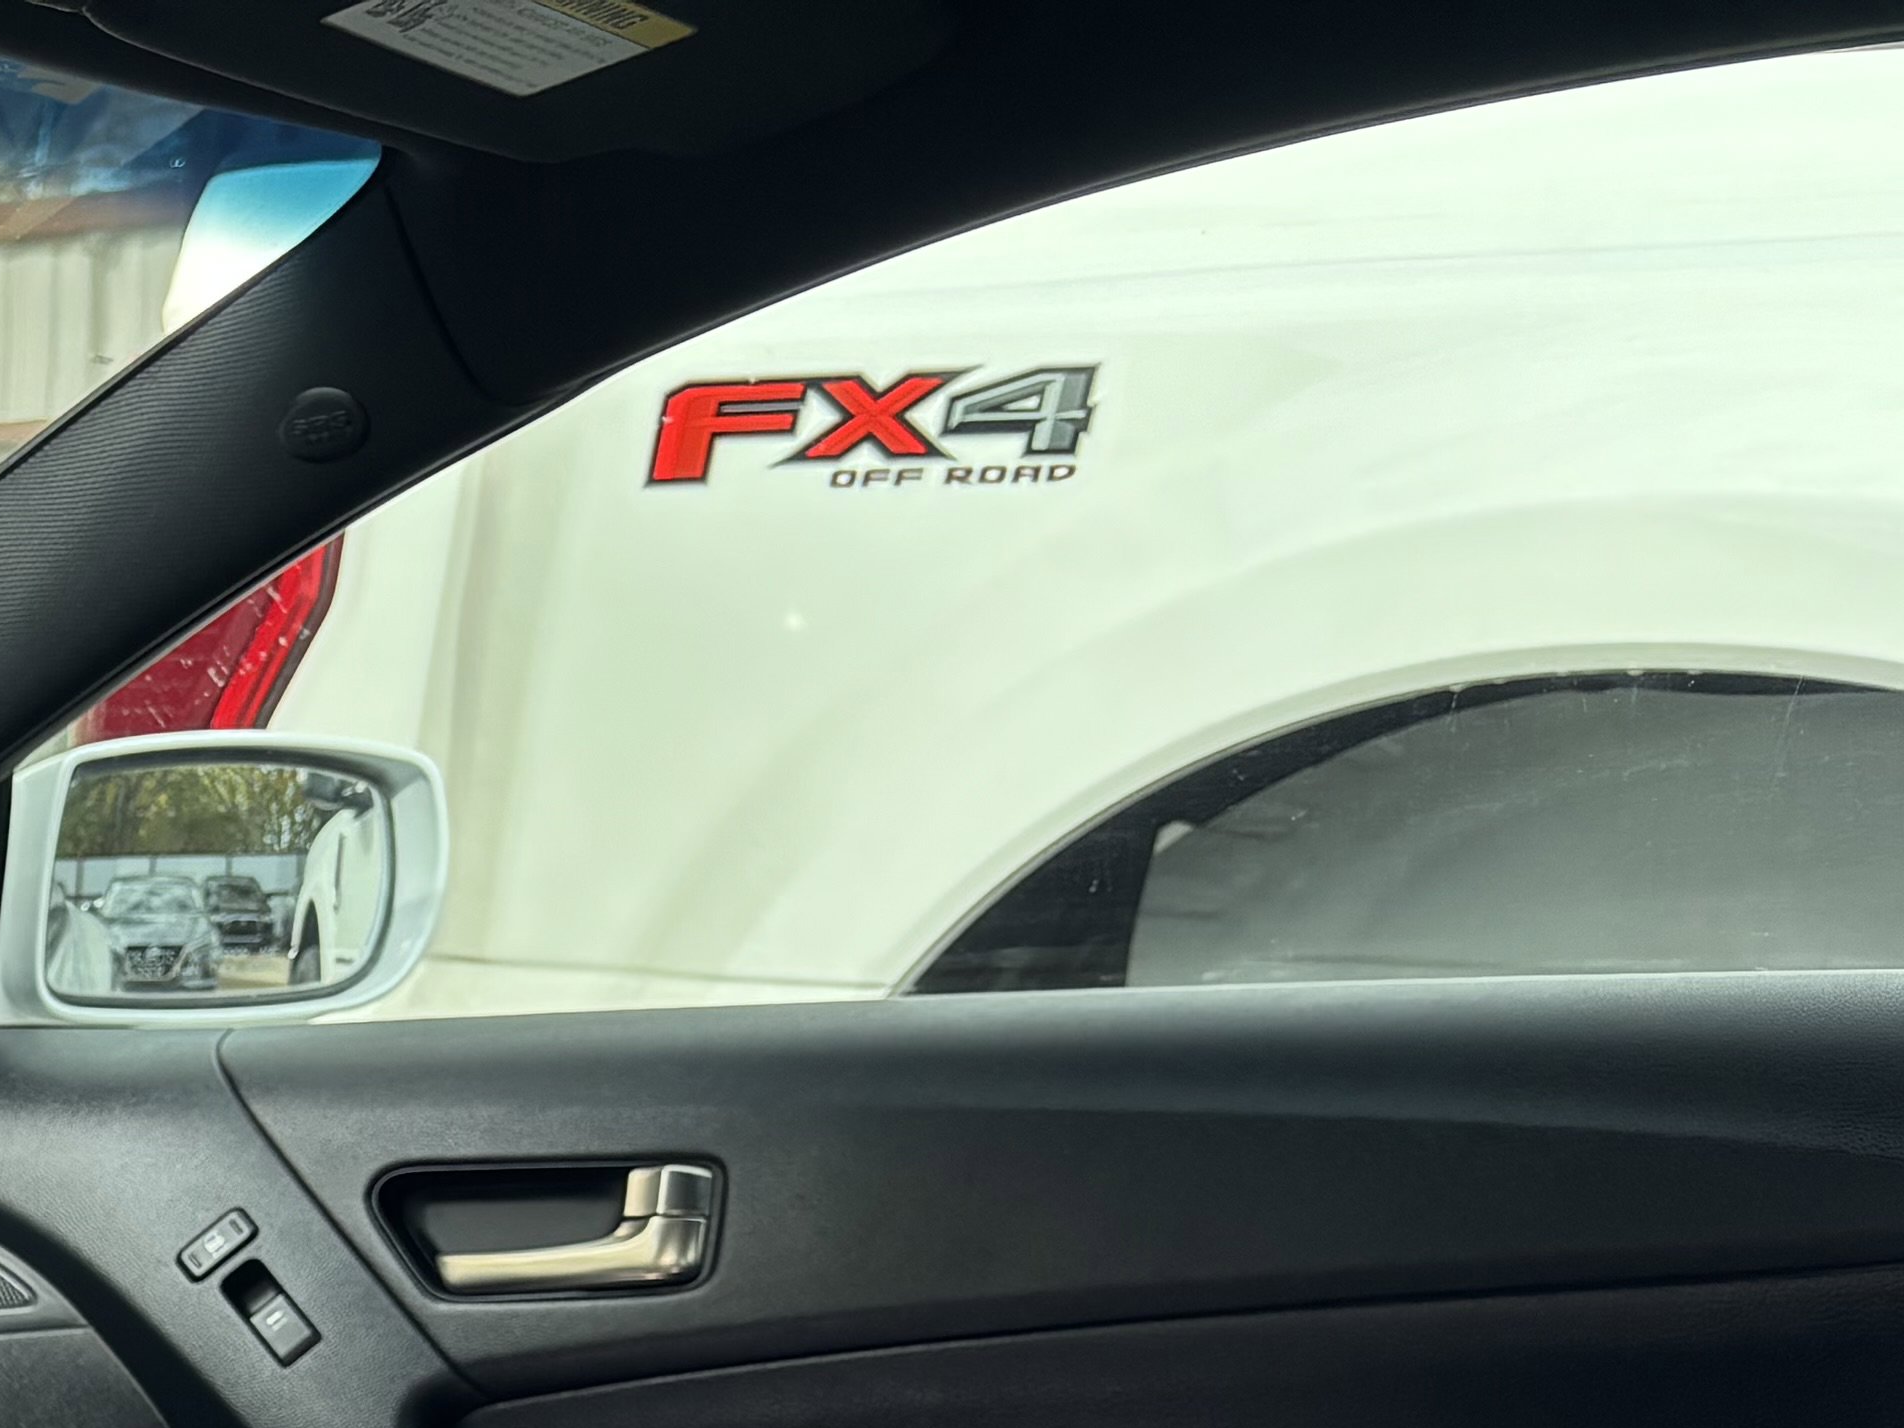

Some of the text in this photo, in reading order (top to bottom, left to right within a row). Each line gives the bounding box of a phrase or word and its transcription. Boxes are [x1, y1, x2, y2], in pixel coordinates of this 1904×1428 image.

[644, 363, 1102, 487] FX4
[829, 463, 1077, 488] OFF ROAD
